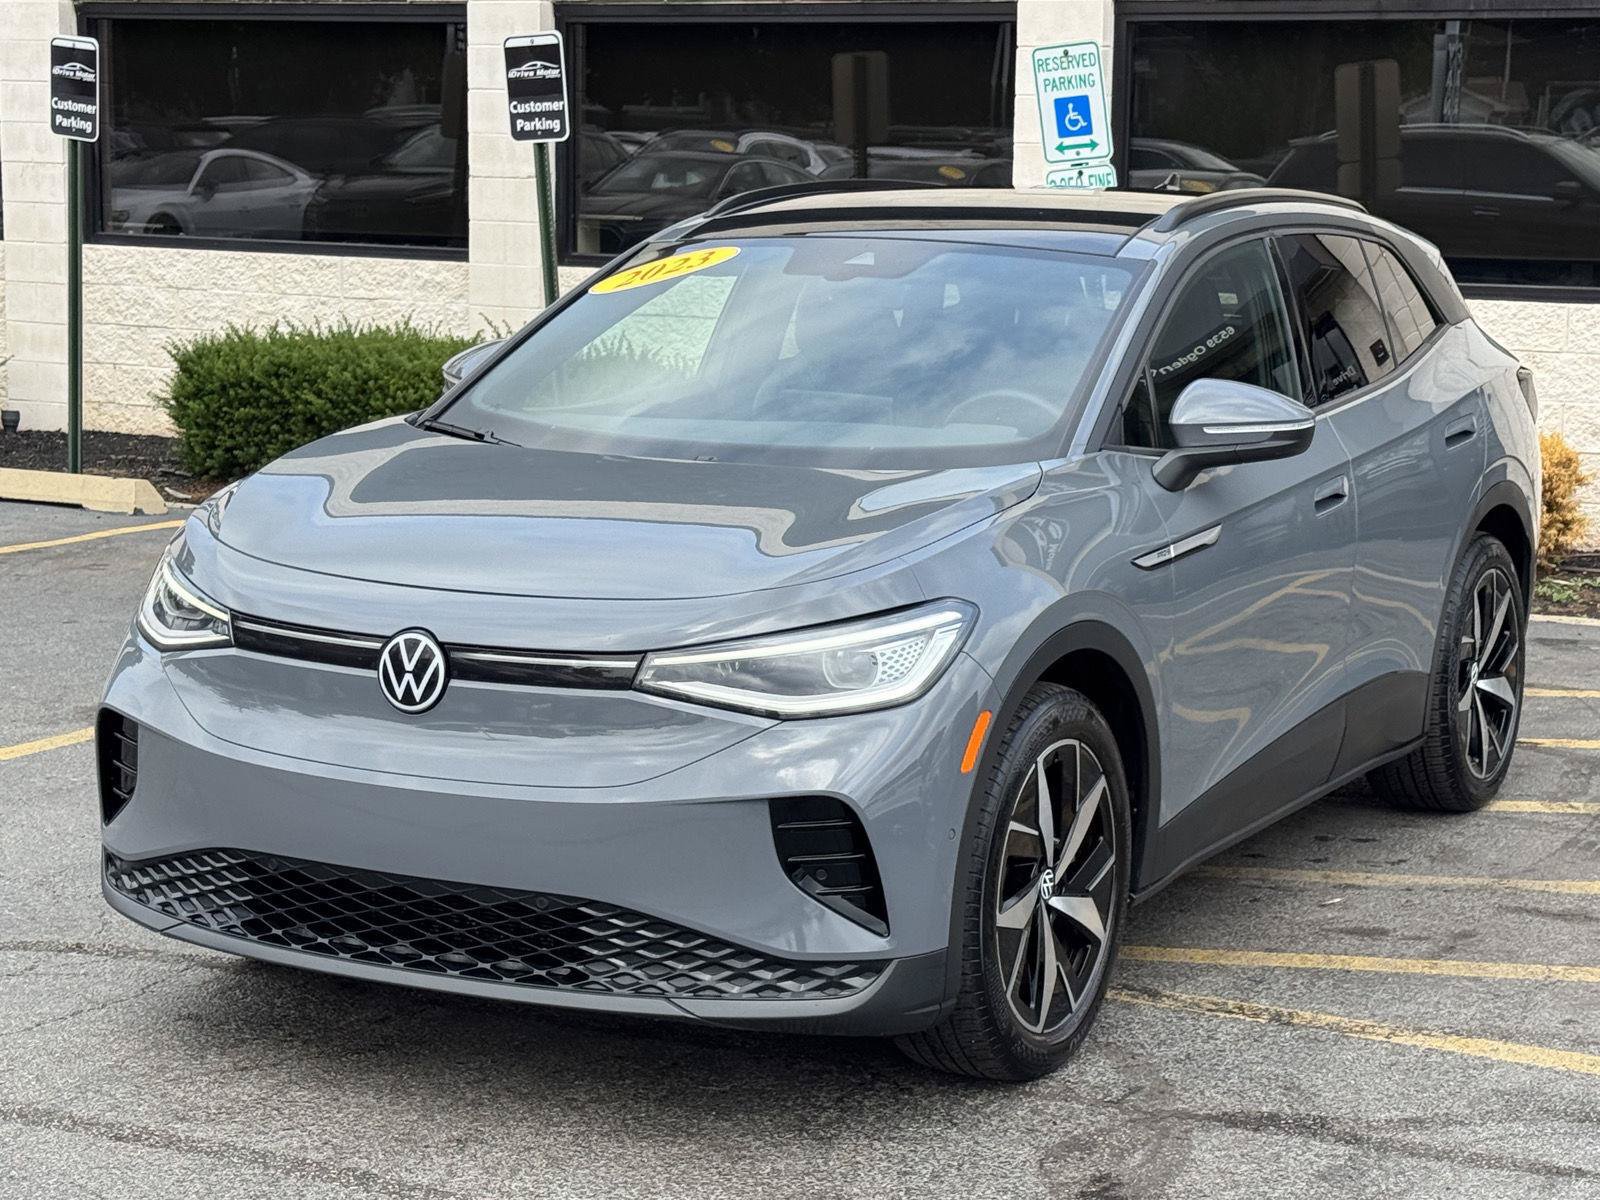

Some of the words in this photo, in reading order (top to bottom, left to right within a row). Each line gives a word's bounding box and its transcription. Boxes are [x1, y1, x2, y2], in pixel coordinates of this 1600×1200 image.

[1036, 52, 1097, 73] RESERVED
[1043, 73, 1096, 93] PARKING
[51, 97, 97, 115] Customer
[509, 100, 565, 114] Customer
[55, 114, 92, 133] Parking
[516, 117, 561, 132] Parking
[615, 251, 716, 289] 2023
